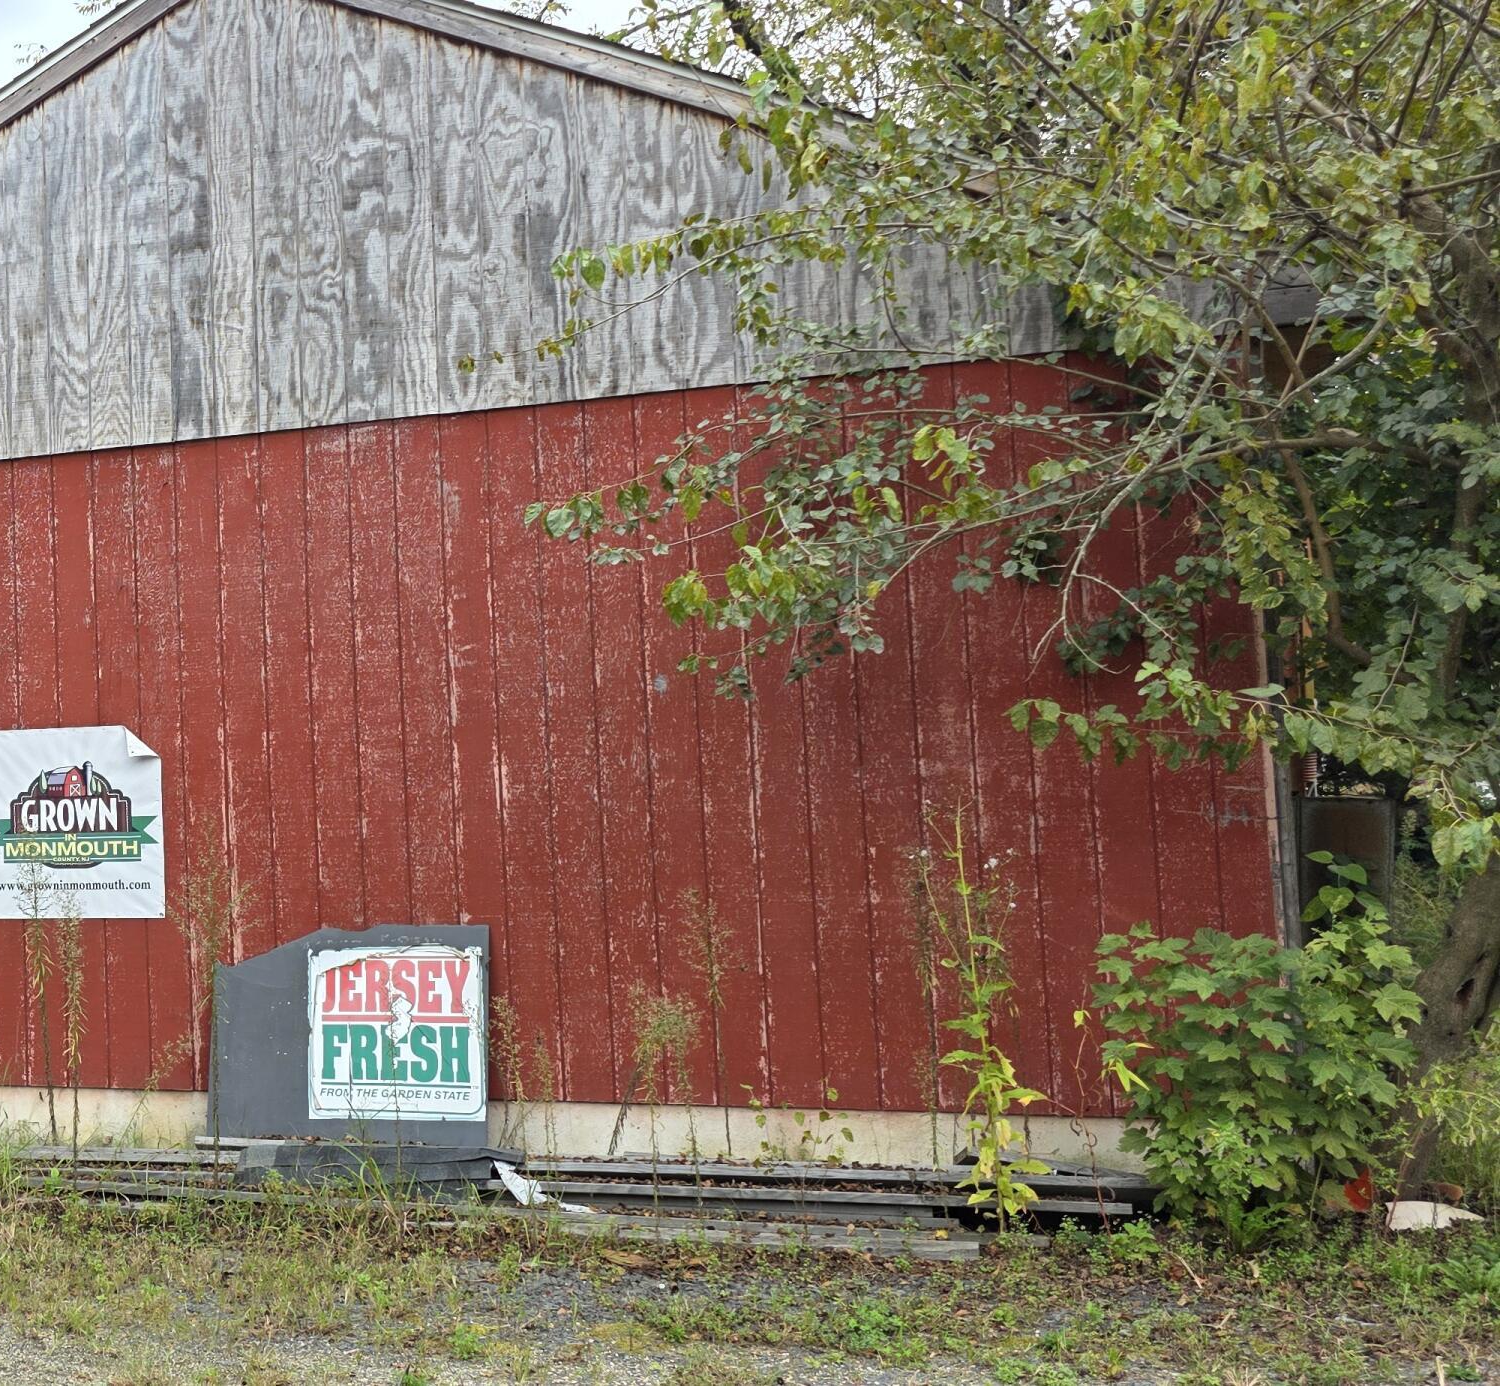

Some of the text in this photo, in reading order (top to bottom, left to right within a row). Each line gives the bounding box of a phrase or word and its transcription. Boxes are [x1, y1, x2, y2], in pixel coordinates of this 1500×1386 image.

[20, 797, 118, 833] GROWN
[5, 840, 138, 858] MONMOUTH
[64, 833, 77, 841] IN
[322, 959, 470, 1013] JERSEY
[321, 1023, 471, 1083] FRESH
[356, 1088, 378, 1098] THE
[381, 1089, 431, 1099] GARDEN
[434, 1090, 470, 1101] STATE
